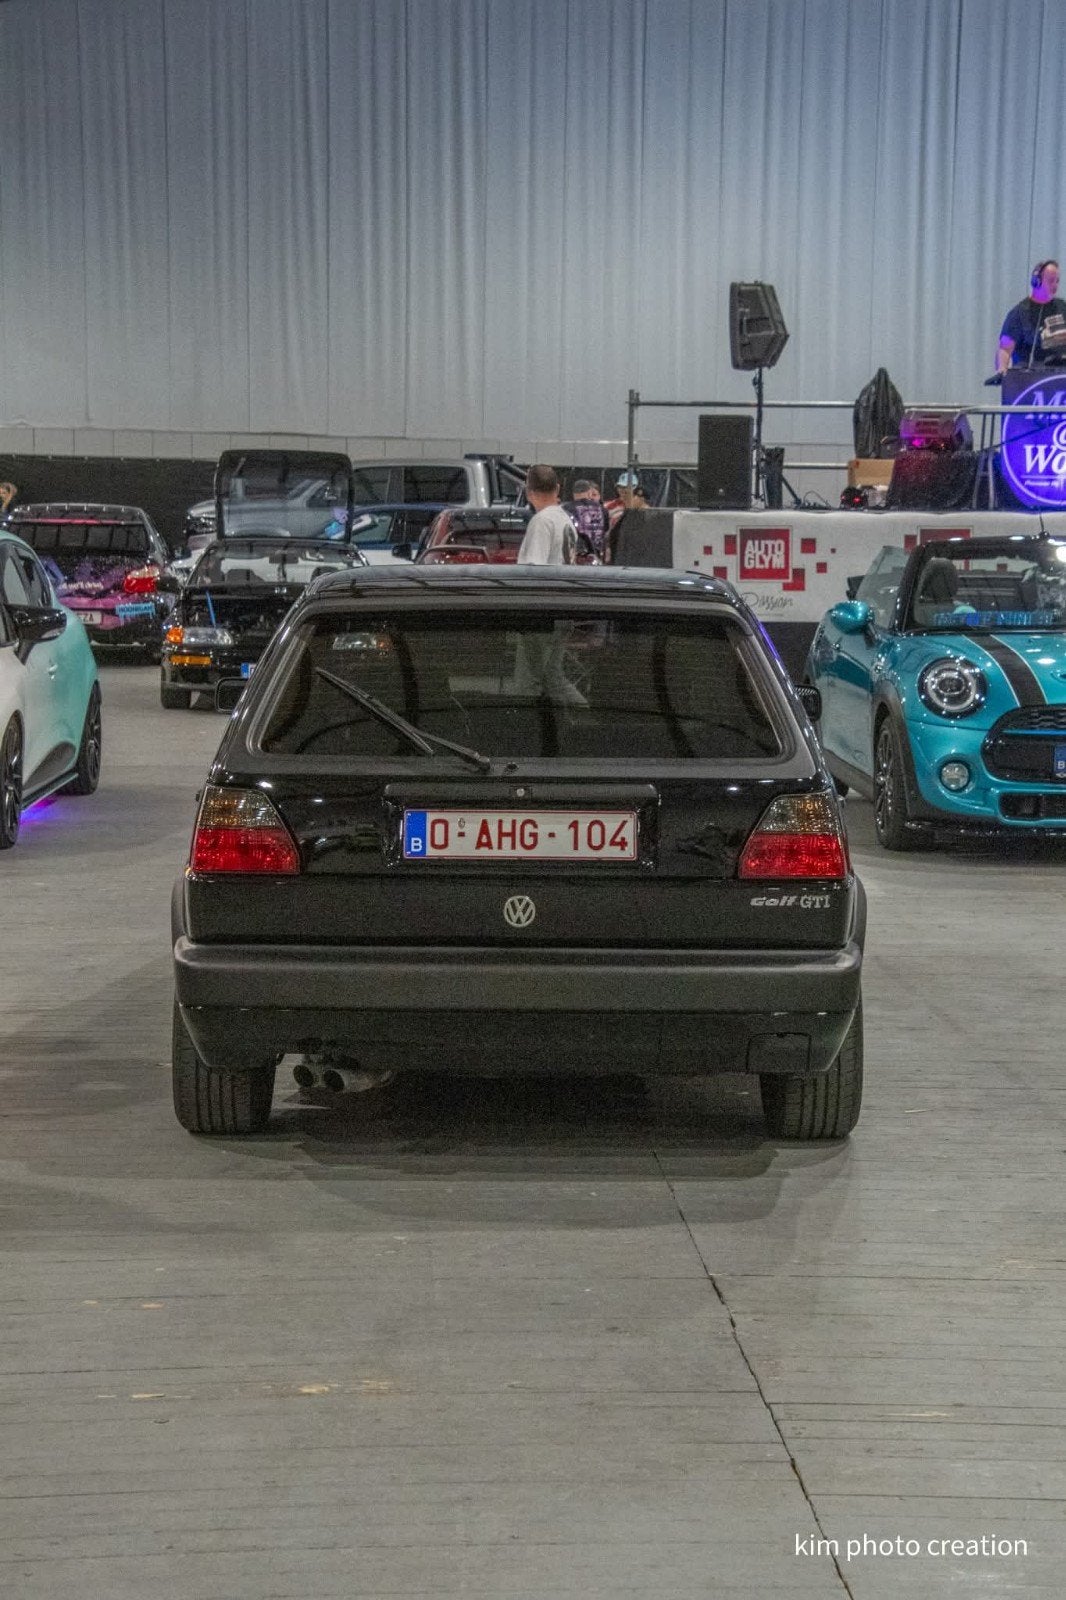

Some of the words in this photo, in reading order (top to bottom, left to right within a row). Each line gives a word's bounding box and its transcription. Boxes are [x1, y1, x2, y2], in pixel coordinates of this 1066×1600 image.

[745, 539, 786, 554] AUTO
[744, 552, 786, 569] GLYM
[410, 837, 423, 852] B
[750, 895, 799, 907] Golf
[800, 894, 831, 909] GTI
